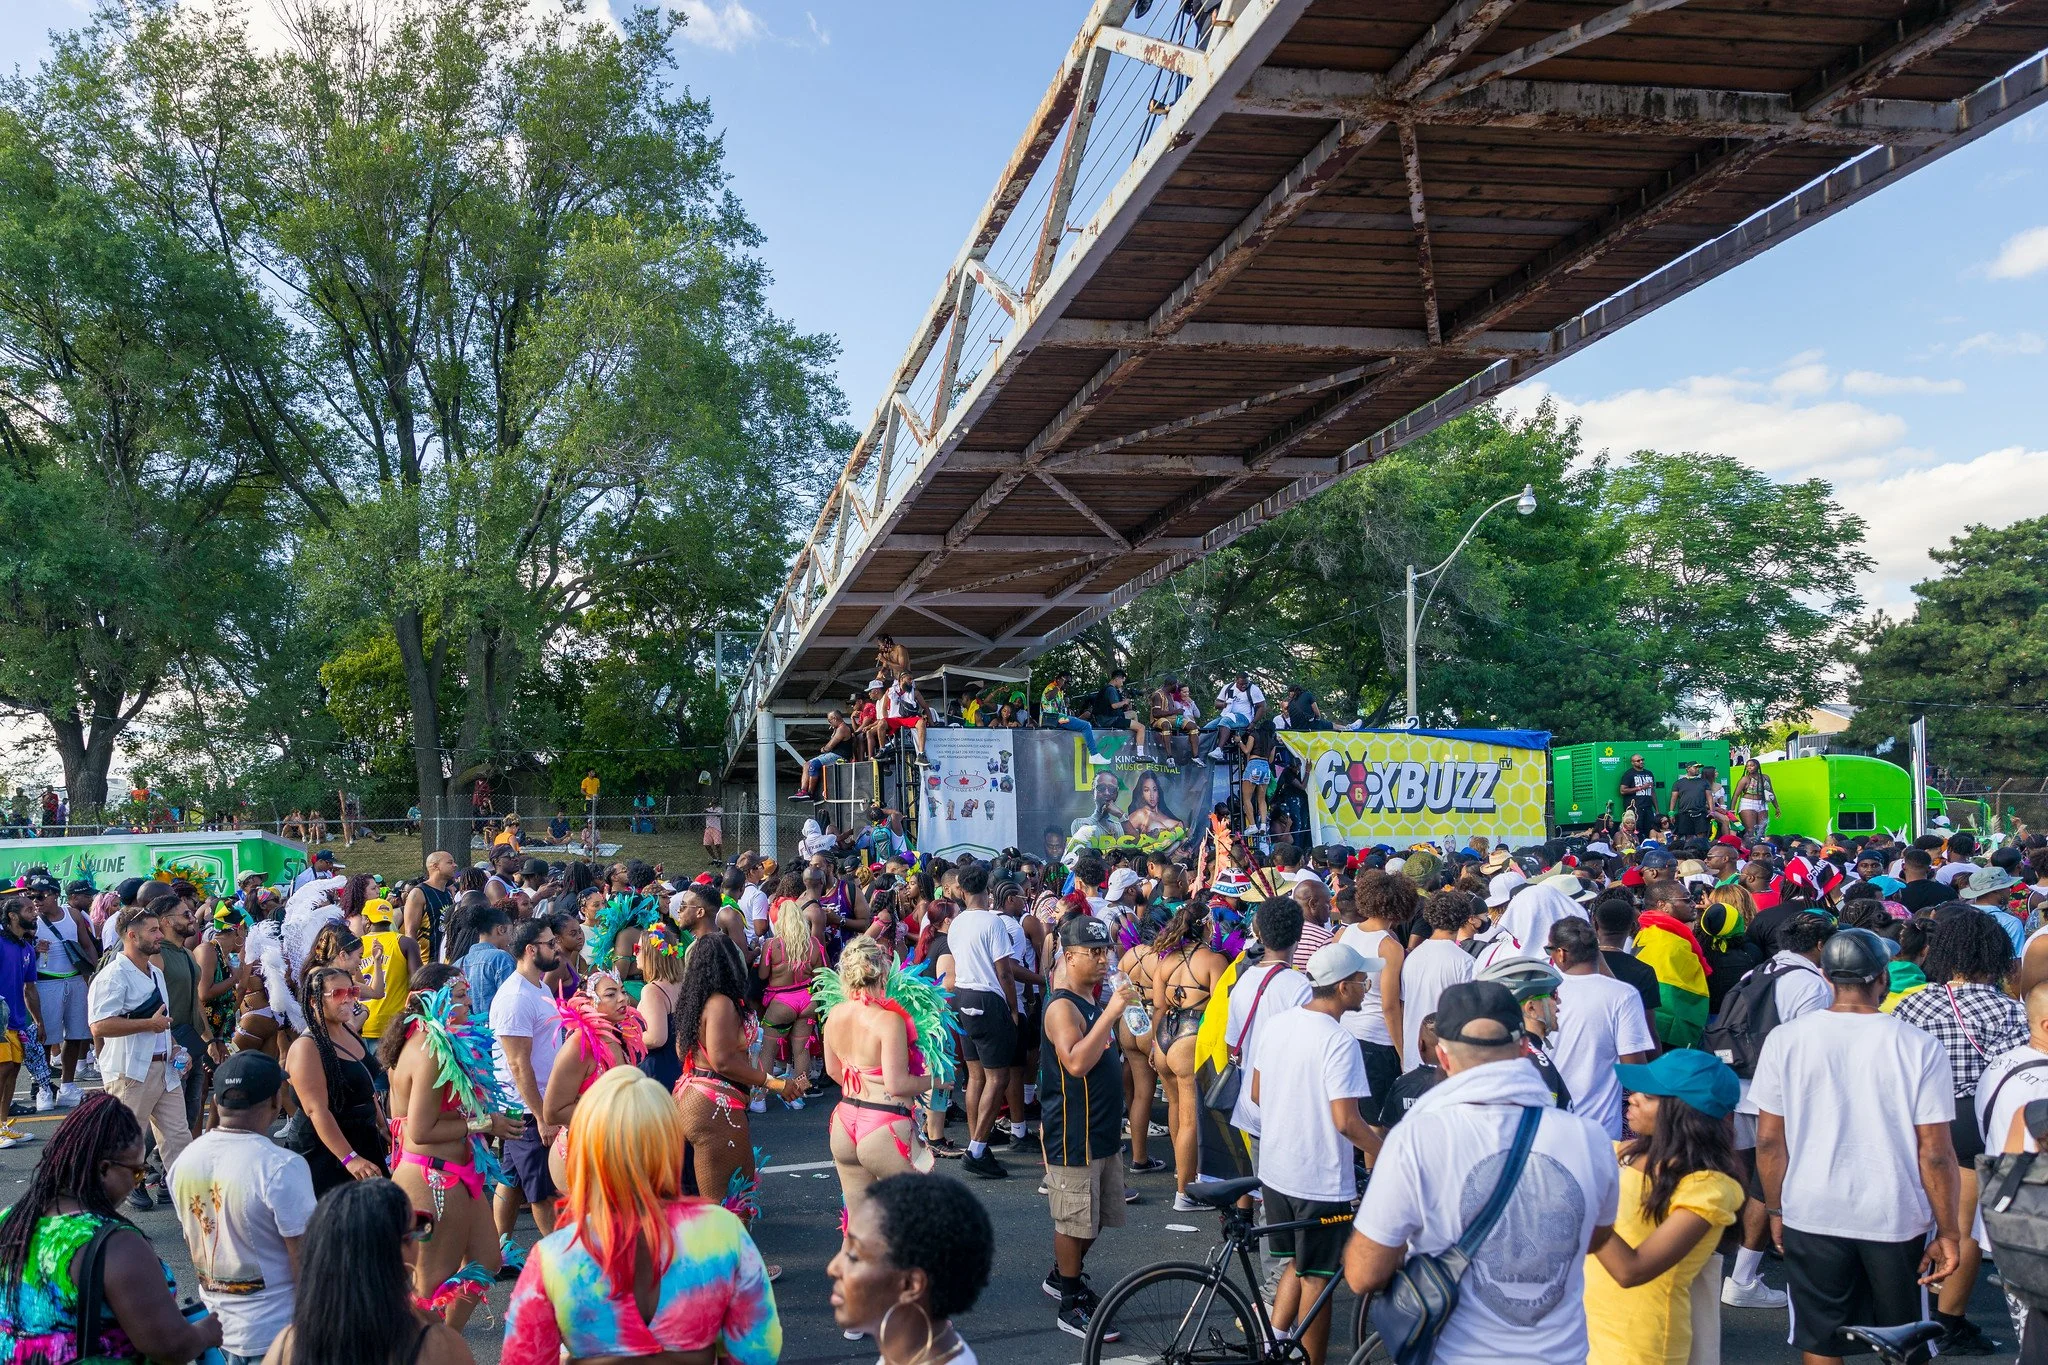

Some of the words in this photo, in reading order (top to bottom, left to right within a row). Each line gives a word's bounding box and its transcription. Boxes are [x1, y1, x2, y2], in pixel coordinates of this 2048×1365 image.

[1407, 717, 1419, 729] 2
[1114, 755, 1159, 763] KINON
[1501, 760, 1511, 768] TV
[1115, 763, 1144, 771] MUSIC
[1146, 763, 1181, 774] FESTIVAL
[1354, 787, 1363, 800] 6
[84, 855, 126, 874] NLINE
[358, 954, 390, 971] RYT
[363, 970, 387, 999] 2
[225, 1077, 243, 1085] BMW
[1320, 1214, 1354, 1225] butter
